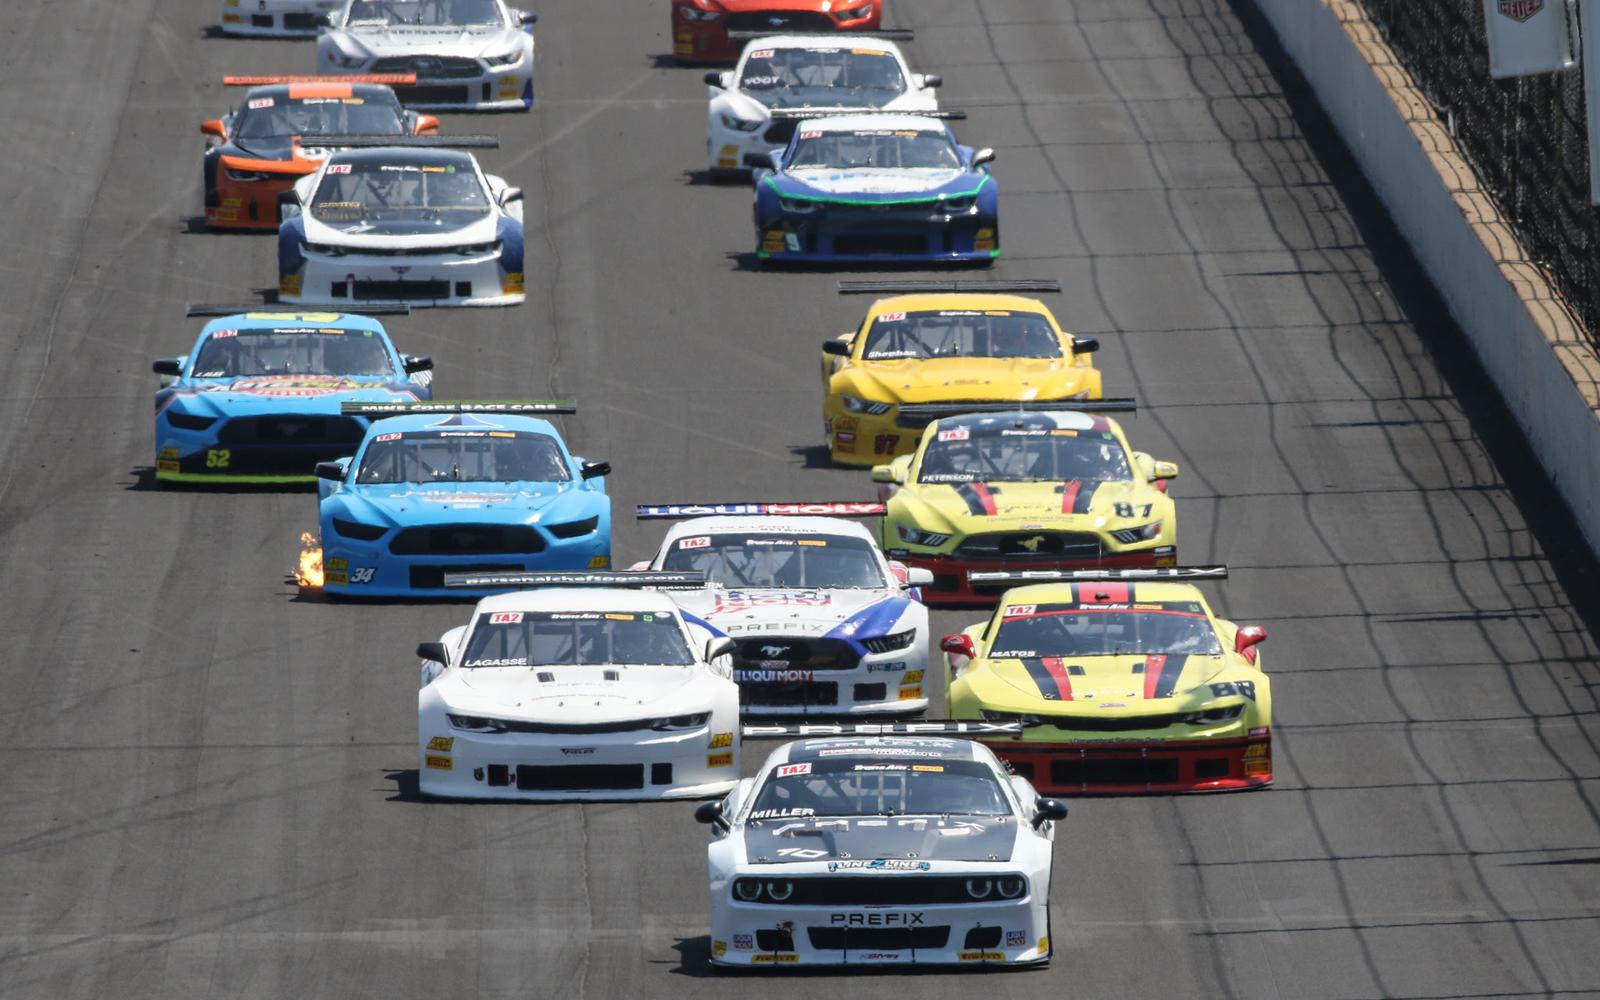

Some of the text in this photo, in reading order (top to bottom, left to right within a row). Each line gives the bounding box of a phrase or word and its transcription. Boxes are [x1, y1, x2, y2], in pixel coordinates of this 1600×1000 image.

[361, 404, 407, 412] MIKE
[206, 449, 231, 468] 52
[921, 473, 975, 482] PETERSON
[648, 503, 876, 515] LIQUI MOLY
[1113, 502, 1153, 518] 87
[683, 538, 708, 548] TA2
[350, 567, 376, 583] 34
[1008, 605, 1034, 616] TA2
[493, 612, 520, 624] TA2
[727, 622, 824, 634] PREFIX
[990, 650, 1036, 658] MATOS
[464, 657, 528, 668] LAGASSE
[776, 670, 812, 682] MOLY
[781, 763, 809, 777] TA2
[751, 807, 815, 819] MILLER
[830, 911, 925, 926] PREFIX
